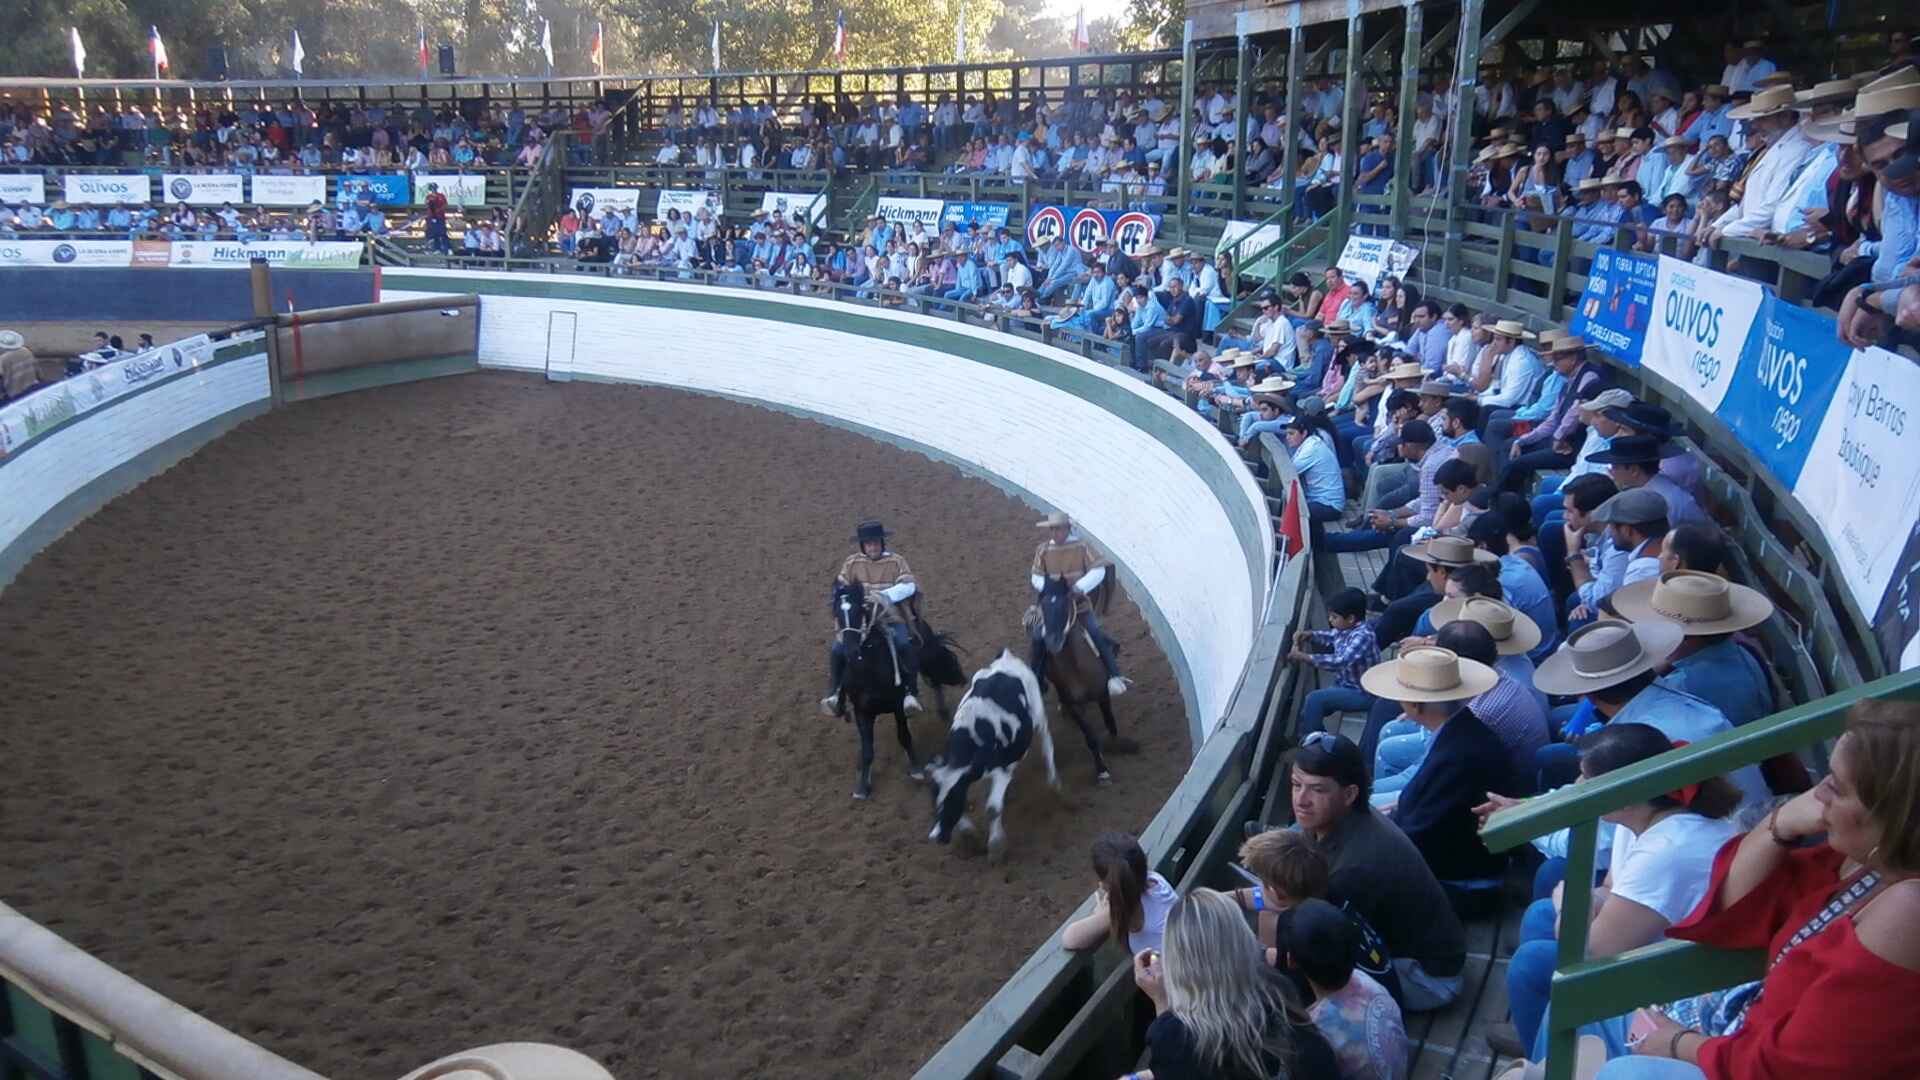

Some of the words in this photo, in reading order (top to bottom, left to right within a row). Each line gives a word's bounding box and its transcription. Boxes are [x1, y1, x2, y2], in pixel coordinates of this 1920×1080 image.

[879, 204, 938, 221] Hickmann
[1078, 218, 1098, 250] PF
[1121, 222, 1144, 254] PF
[213, 247, 286, 259] Hickmann
[1665, 289, 1724, 348] OLIVOS
[1866, 383, 1907, 437] Barros
